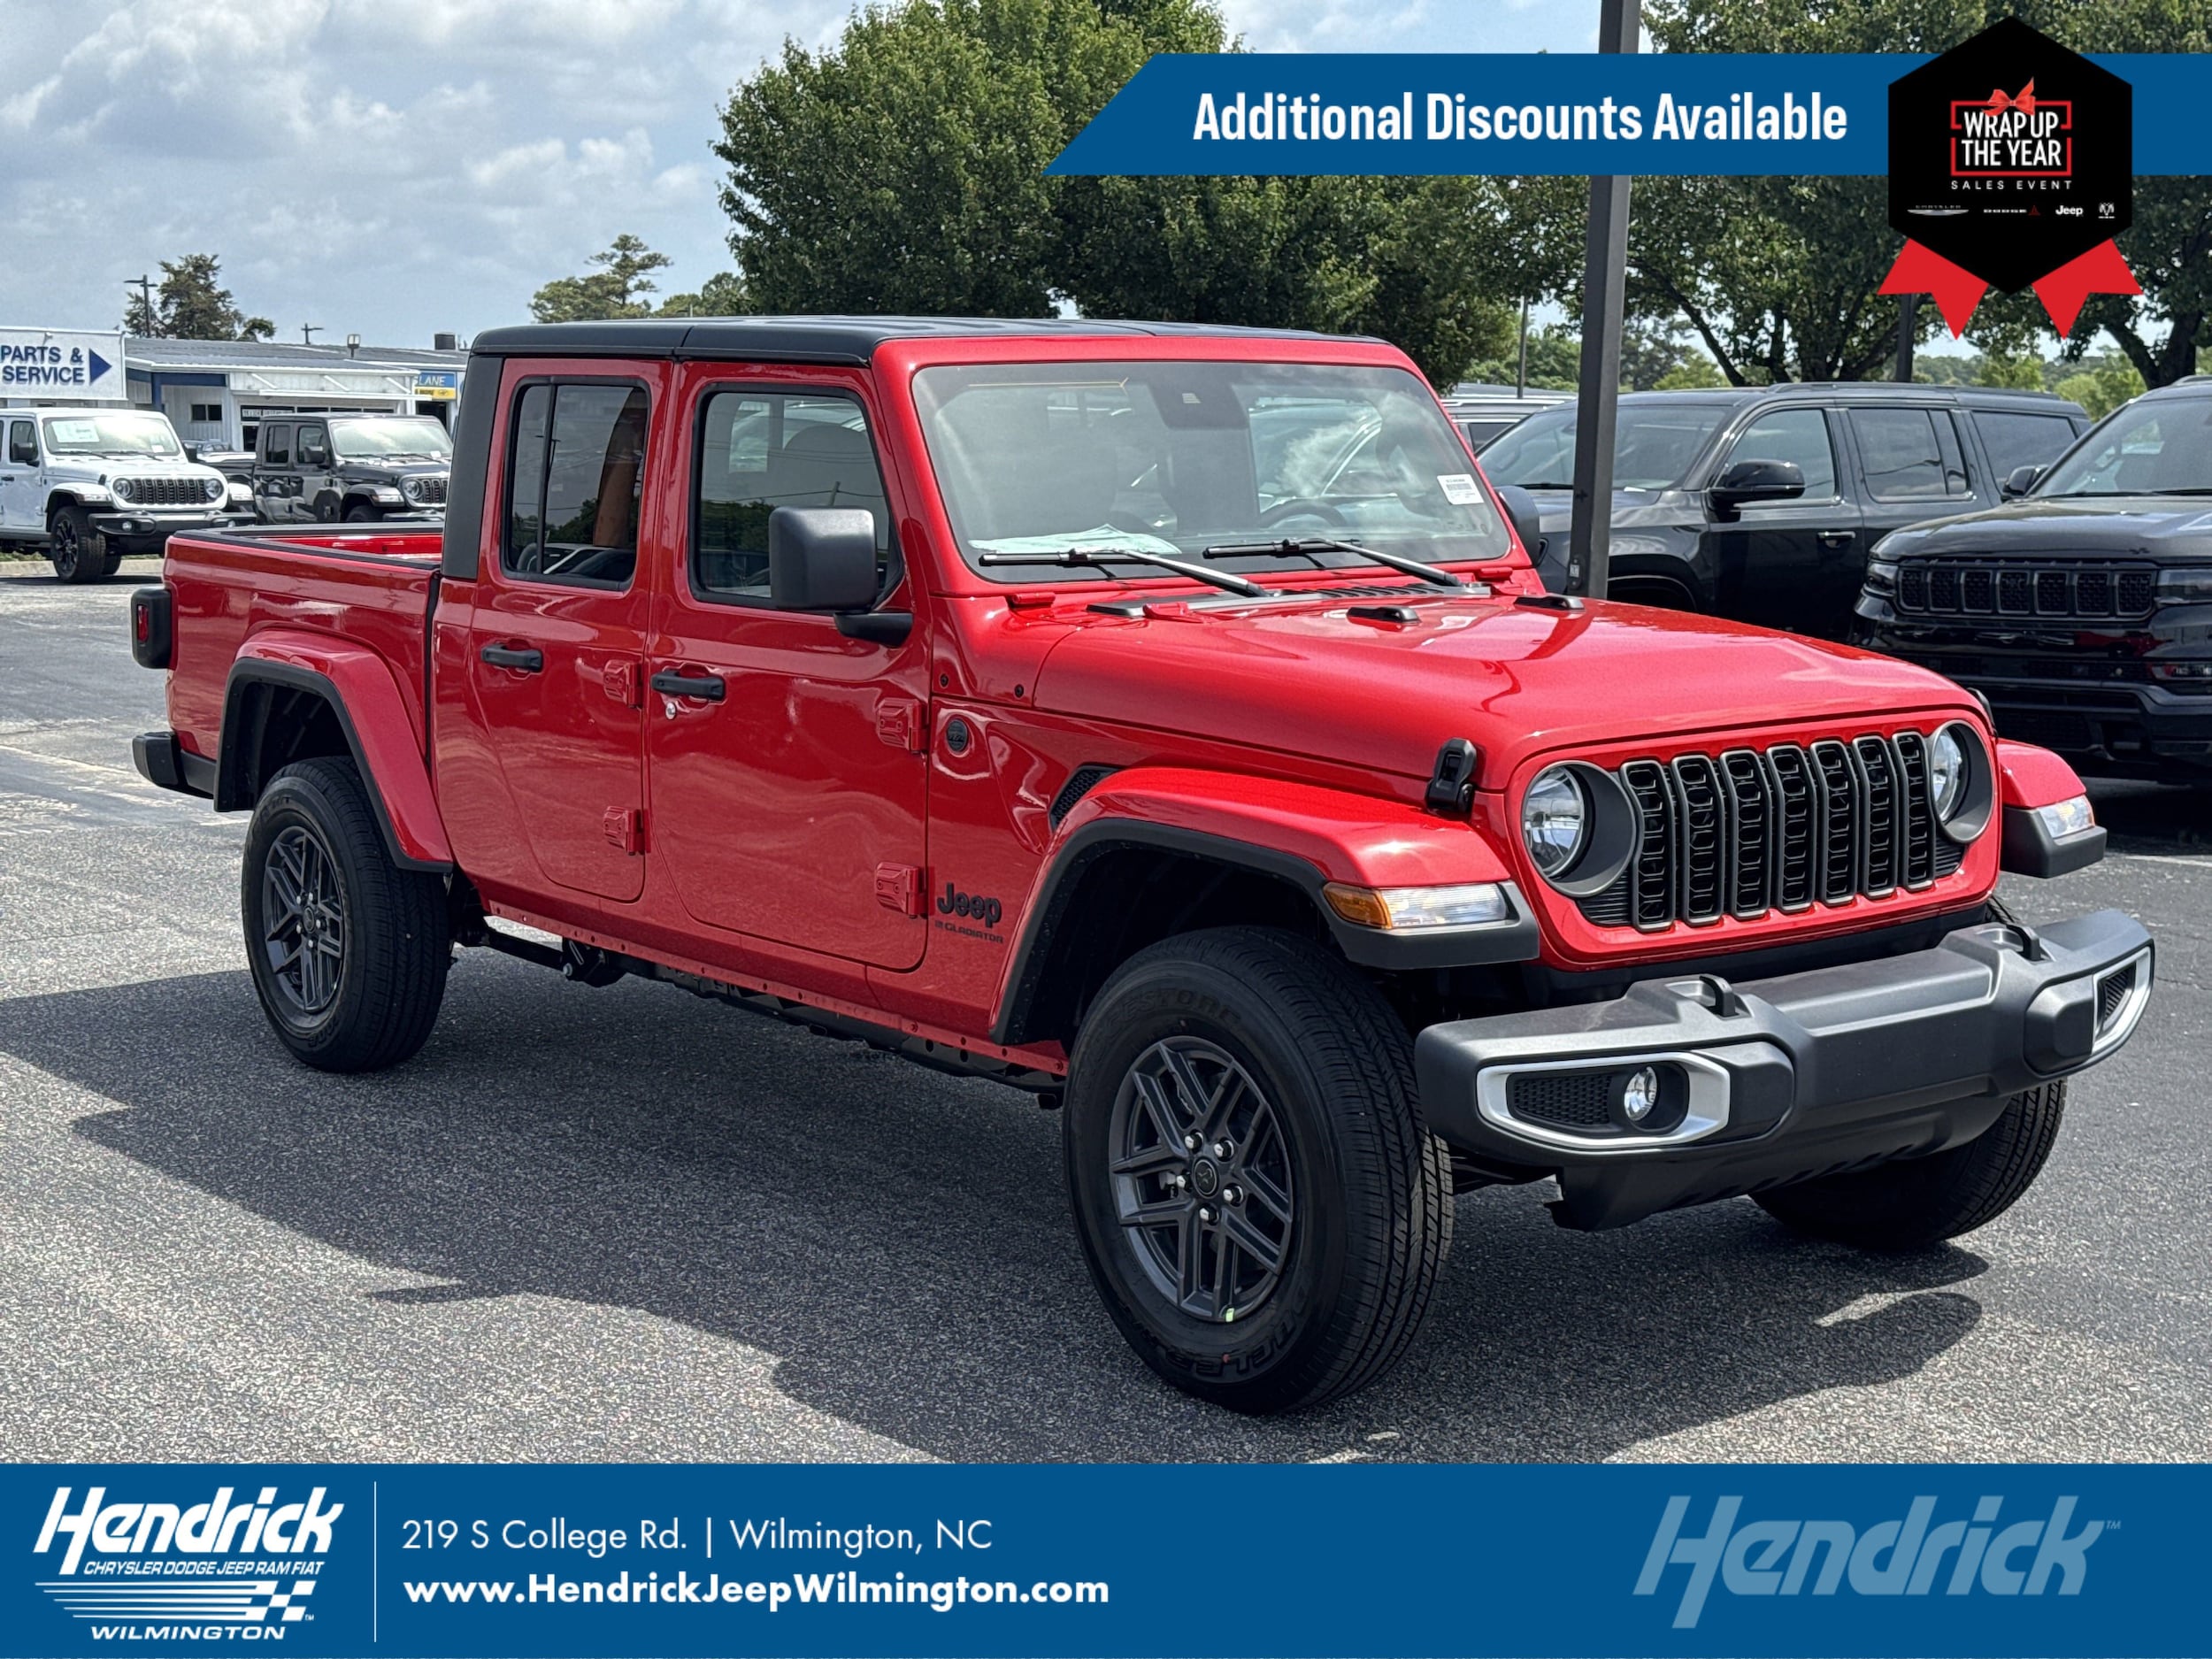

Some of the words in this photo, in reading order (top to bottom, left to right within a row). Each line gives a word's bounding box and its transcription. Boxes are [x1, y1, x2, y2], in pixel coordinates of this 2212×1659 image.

[0, 344, 61, 364] PARTS
[70, 347, 84, 365] &
[2, 365, 86, 385] SERVICE
[419, 375, 447, 386] LANE
[936, 881, 1002, 928] Jeep
[944, 921, 1004, 944] GLADIATOR
